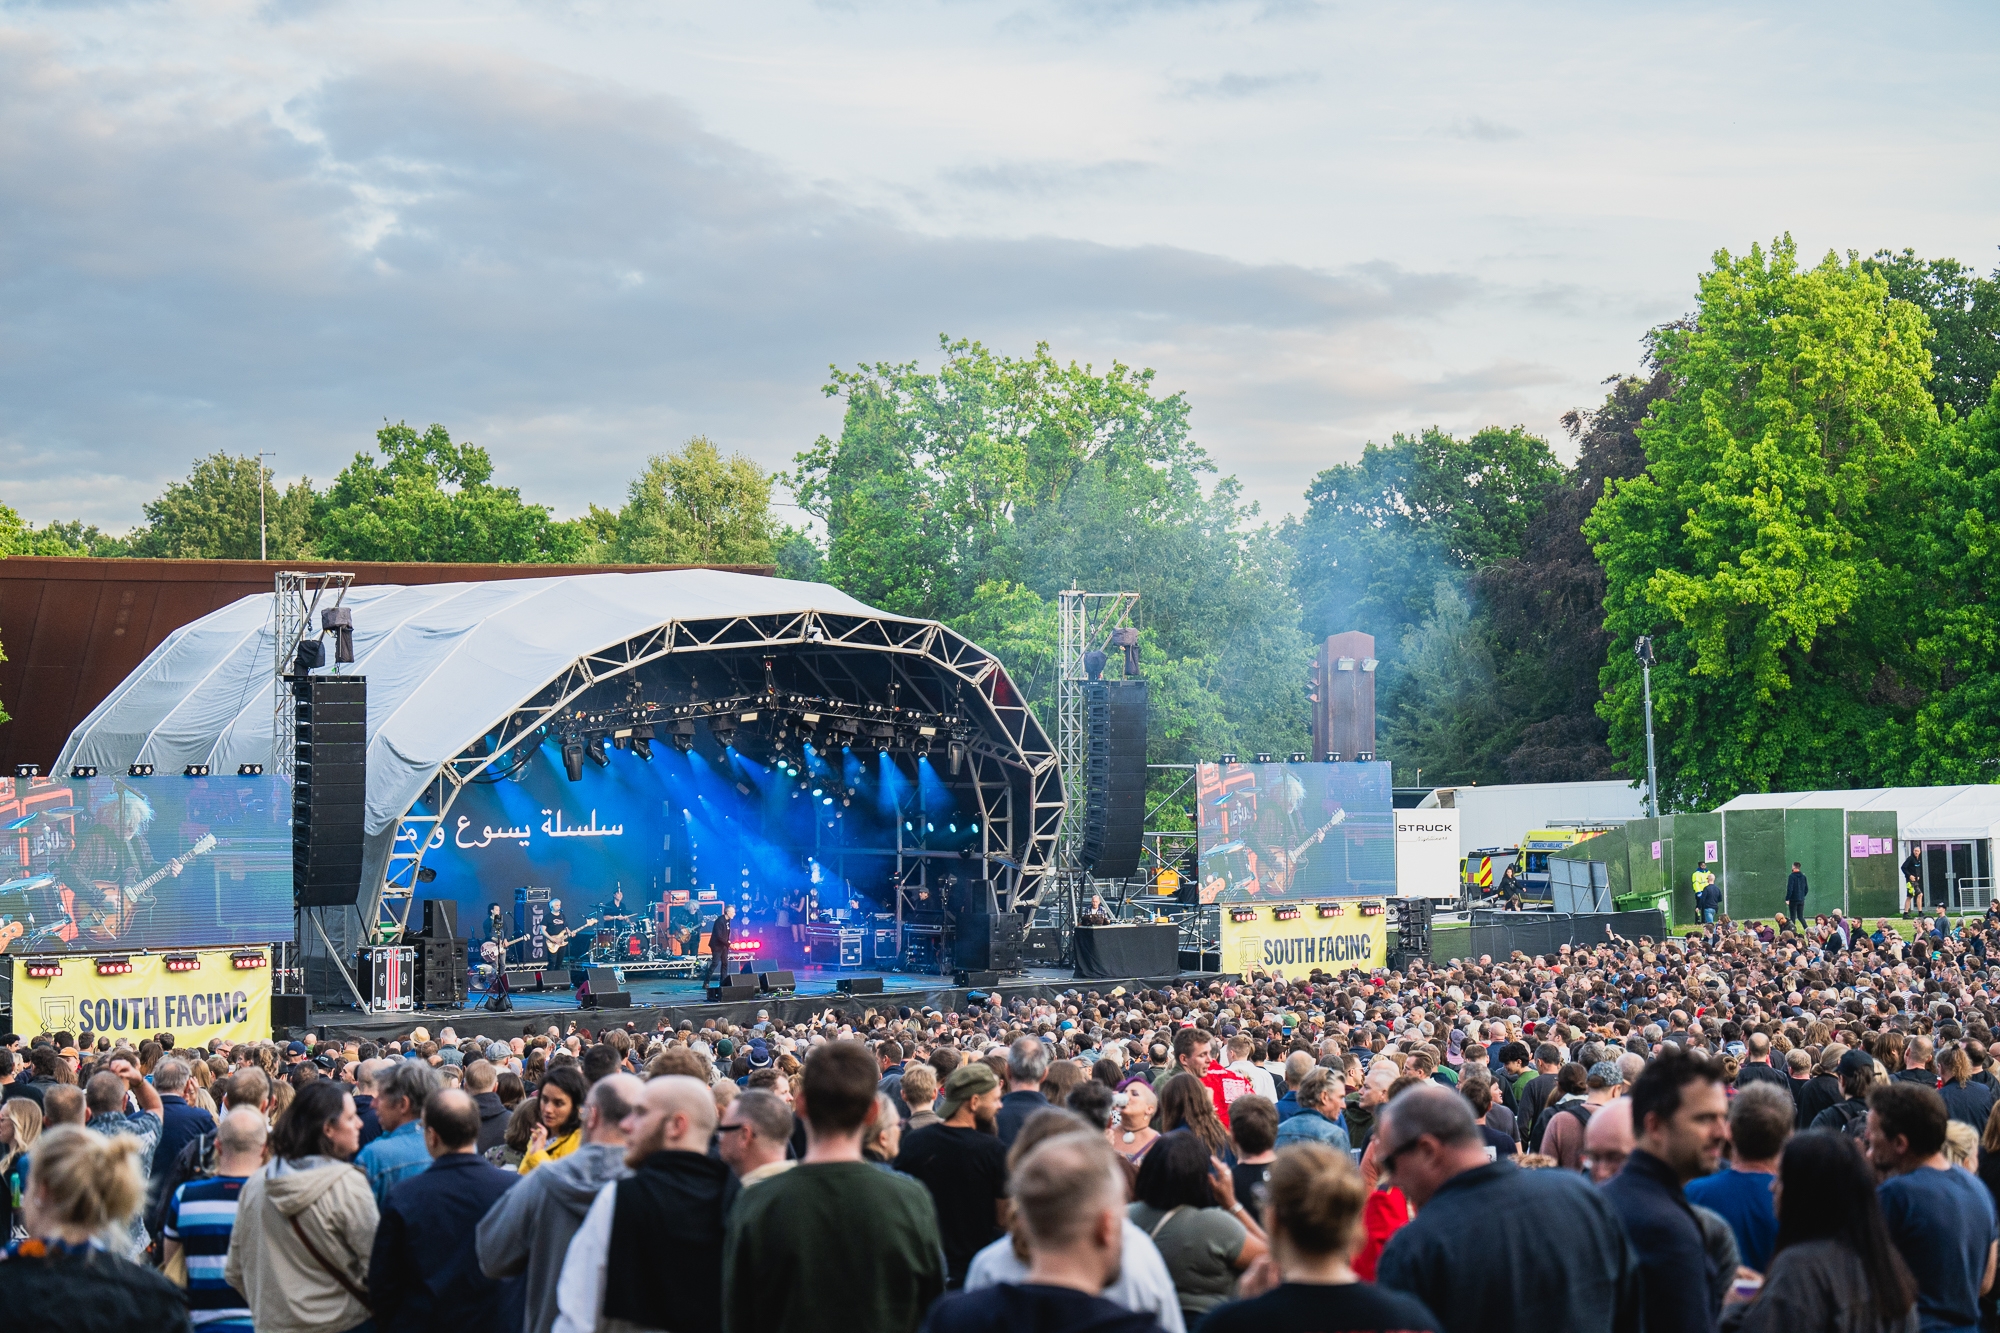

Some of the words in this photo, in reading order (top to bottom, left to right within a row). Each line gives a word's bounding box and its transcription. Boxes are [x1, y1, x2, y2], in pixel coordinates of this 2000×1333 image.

[428, 825, 445, 849] و
[455, 814, 531, 849] يسوع
[540, 808, 624, 837] سلسلة
[1398, 824, 1452, 832] STRUCK
[32, 831, 67, 857] JEUS
[1708, 849, 1714, 859] K
[532, 904, 544, 959] JESUS
[1263, 937, 1316, 966] SOUTH
[1318, 933, 1371, 963] FACING
[79, 996, 160, 1033] SOUTH
[164, 990, 248, 1028] FACING
